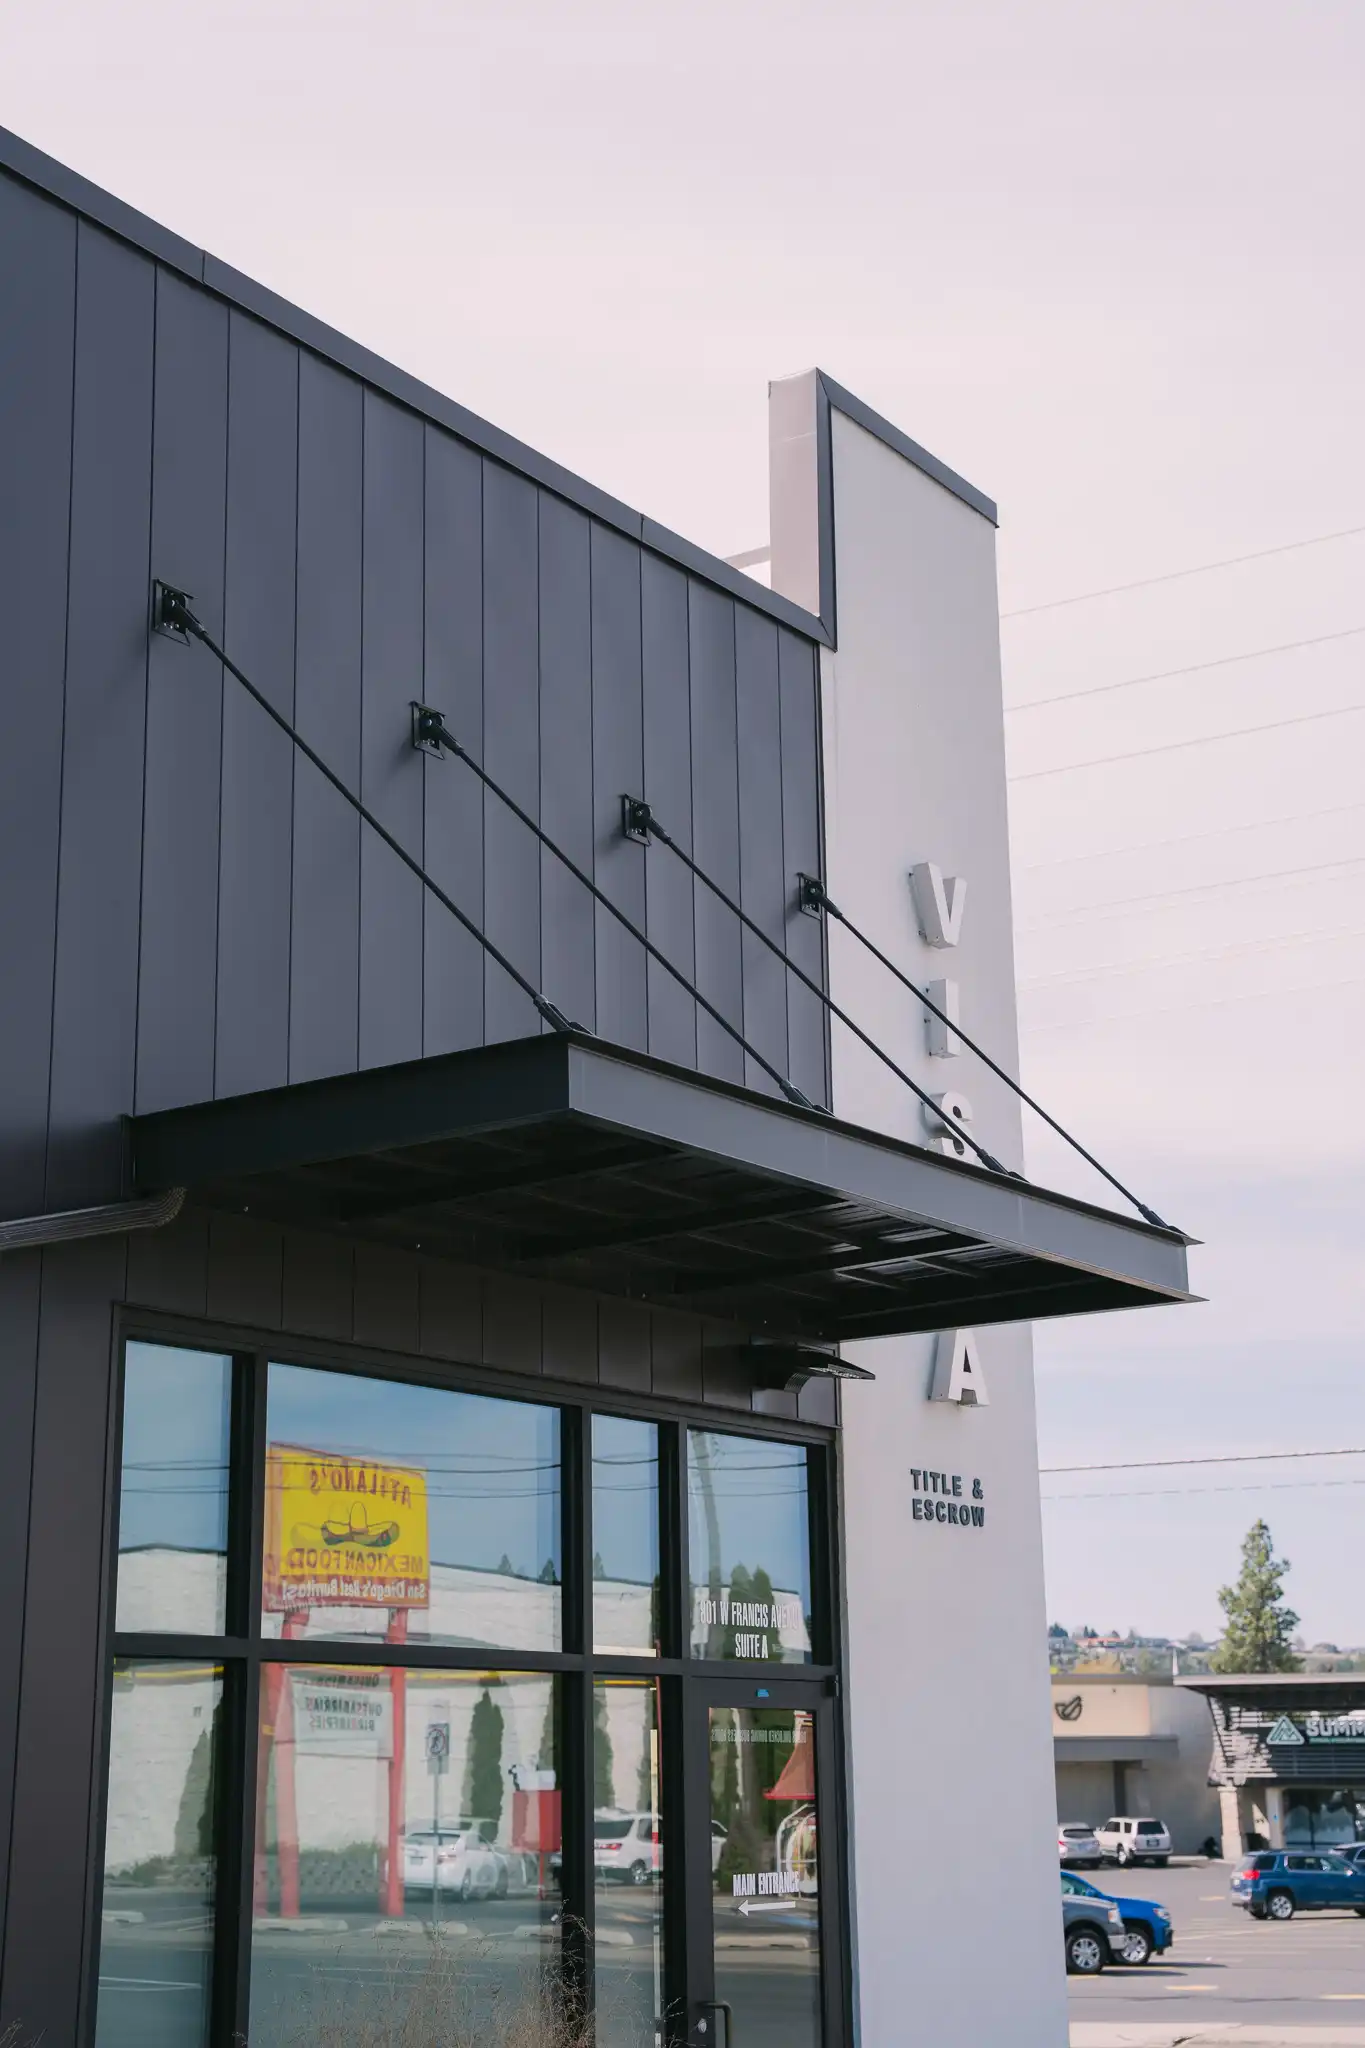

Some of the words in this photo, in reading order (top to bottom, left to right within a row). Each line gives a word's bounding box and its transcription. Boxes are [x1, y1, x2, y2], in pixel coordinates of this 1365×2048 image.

[910, 862, 990, 1408] VISA
[910, 1468, 962, 1497] TITLE
[972, 1478, 984, 1500] &
[912, 1498, 985, 1528] ESCROW
[720, 1600, 730, 1625] W
[731, 1602, 769, 1628] FRANCIS
[771, 1603, 804, 1632] AVENU
[735, 1633, 760, 1658] SUITE
[762, 1635, 769, 1659] A
[733, 1873, 756, 1897] MAIN
[758, 1871, 800, 1895] ENTRANCE
